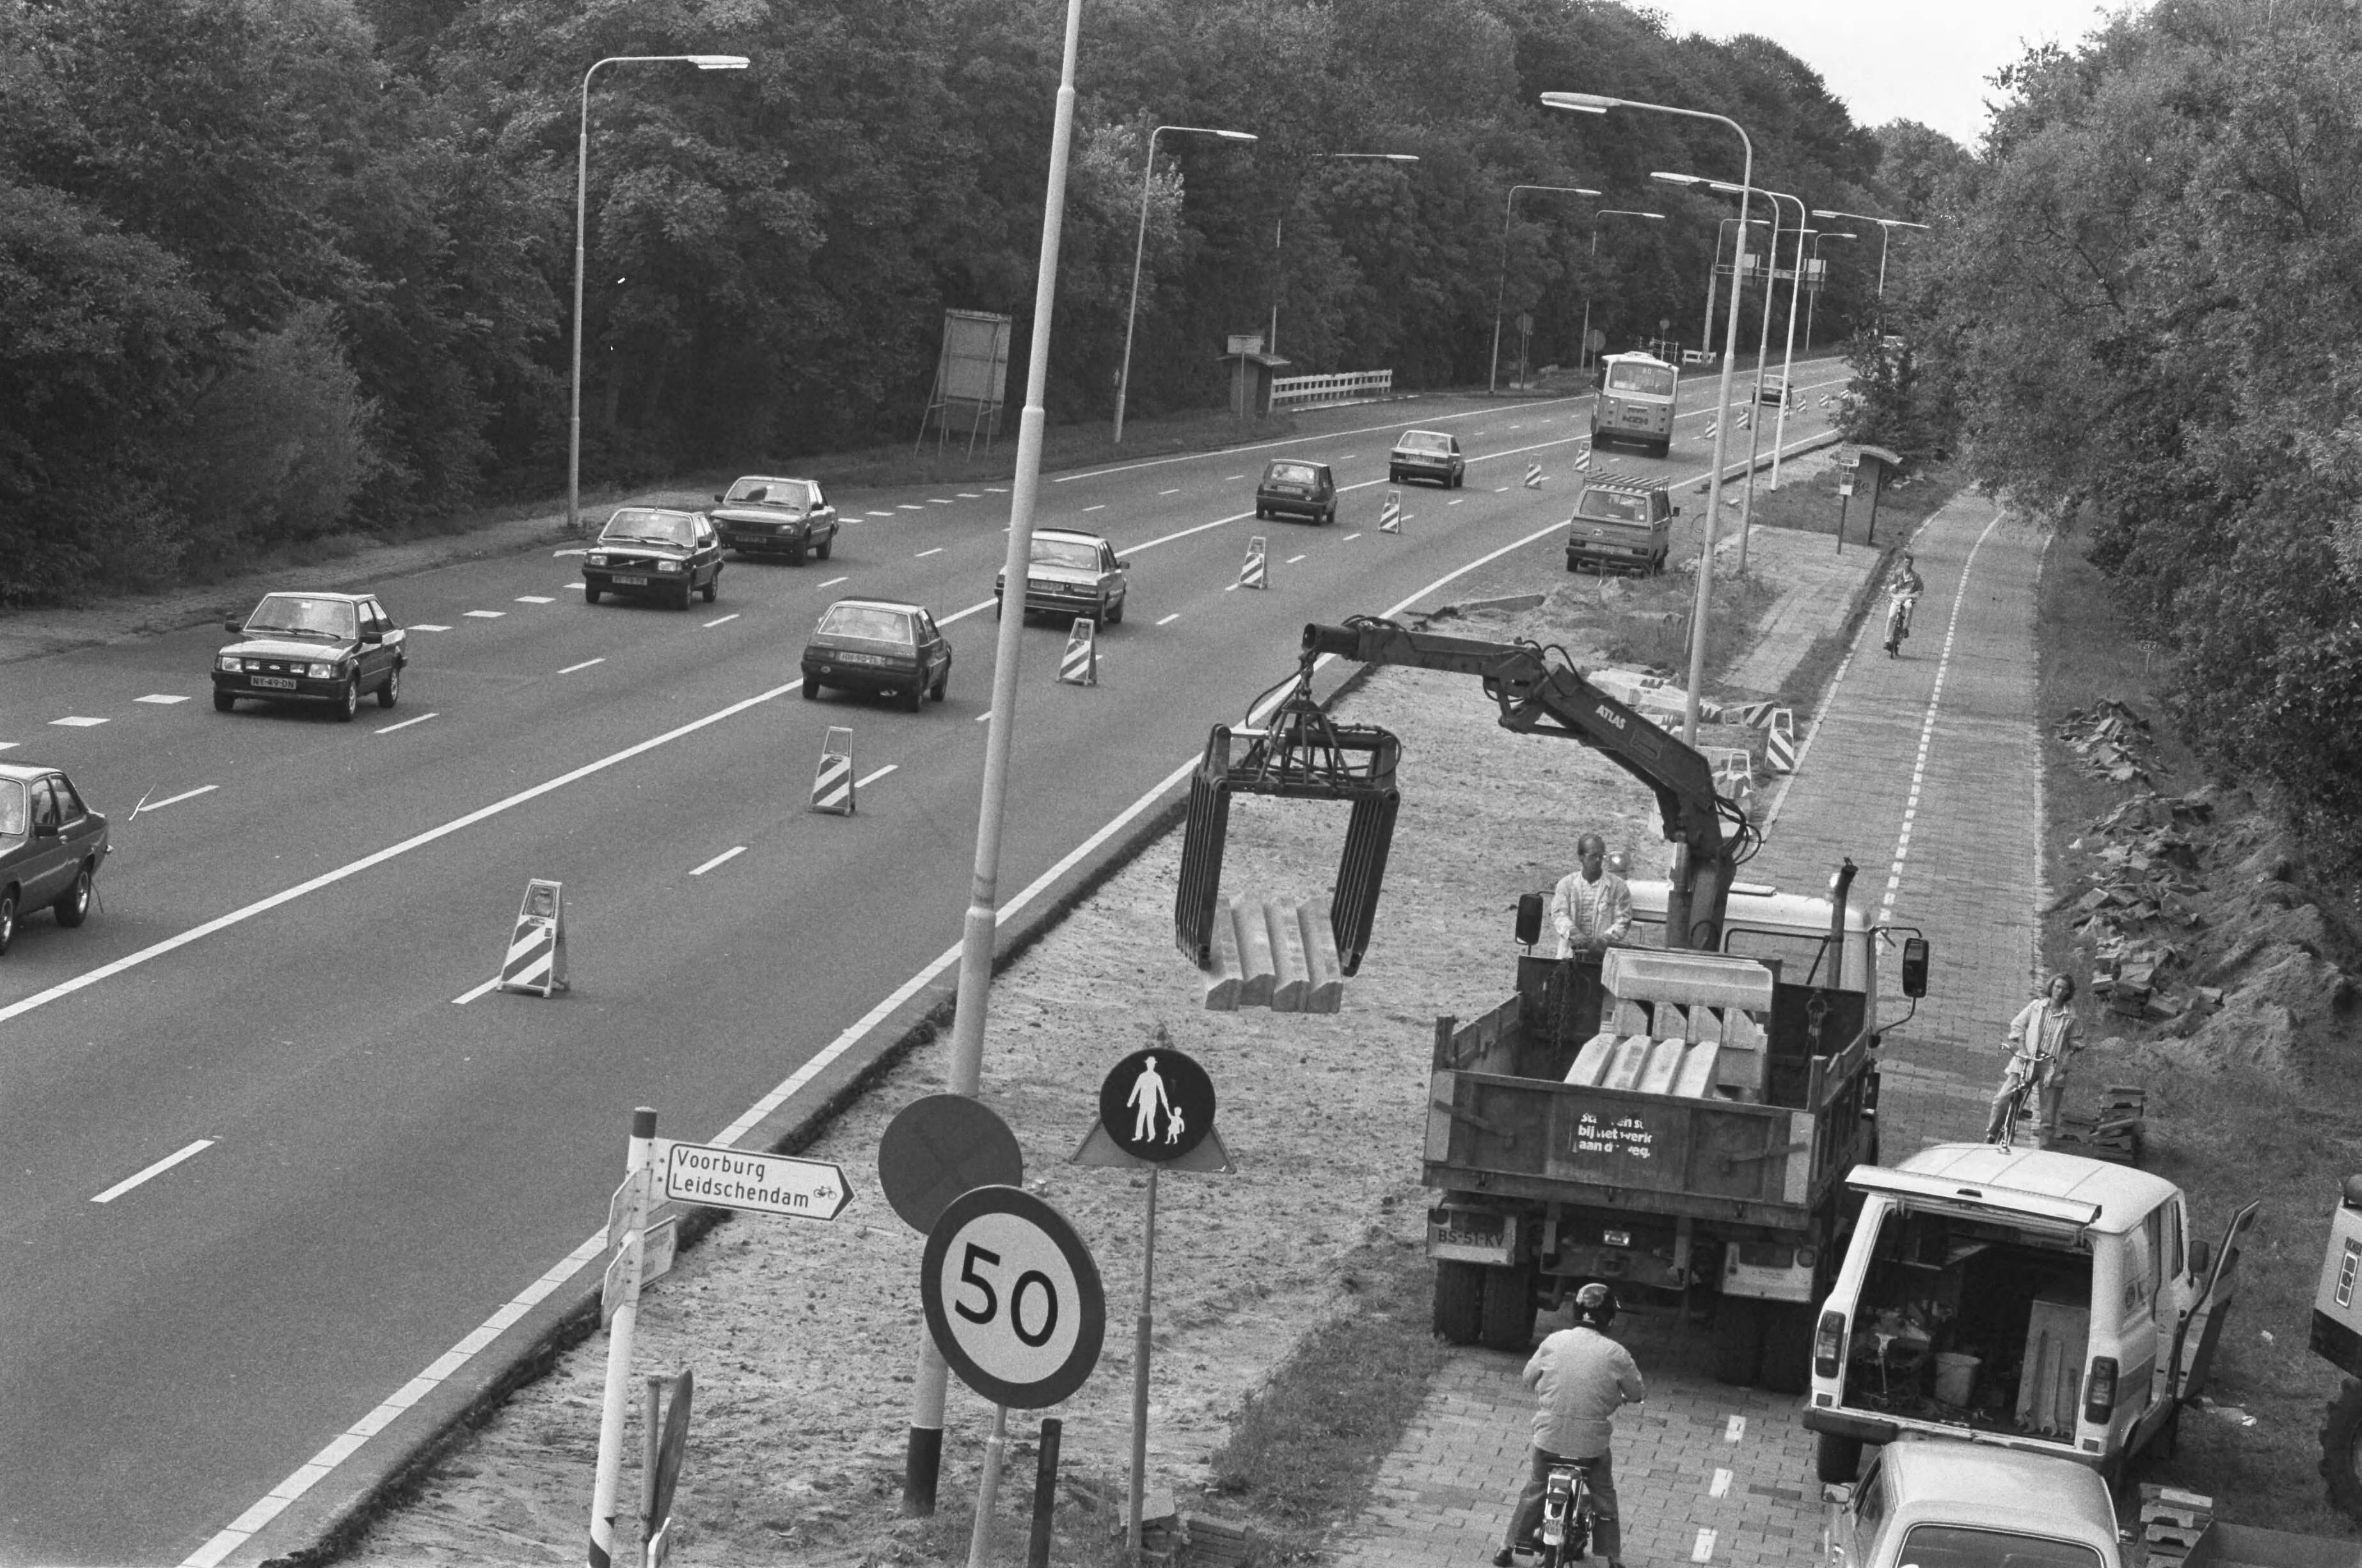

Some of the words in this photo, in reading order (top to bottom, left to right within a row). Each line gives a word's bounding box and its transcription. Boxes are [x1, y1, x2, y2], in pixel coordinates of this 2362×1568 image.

[1595, 704, 1626, 729] ATLAS
[1578, 1125, 1595, 1139] bij
[1579, 1141, 1602, 1151] aan
[678, 1149, 765, 1182] Voorburg
[672, 1173, 809, 1208] Leidschendam
[955, 1242, 1058, 1347] 50
